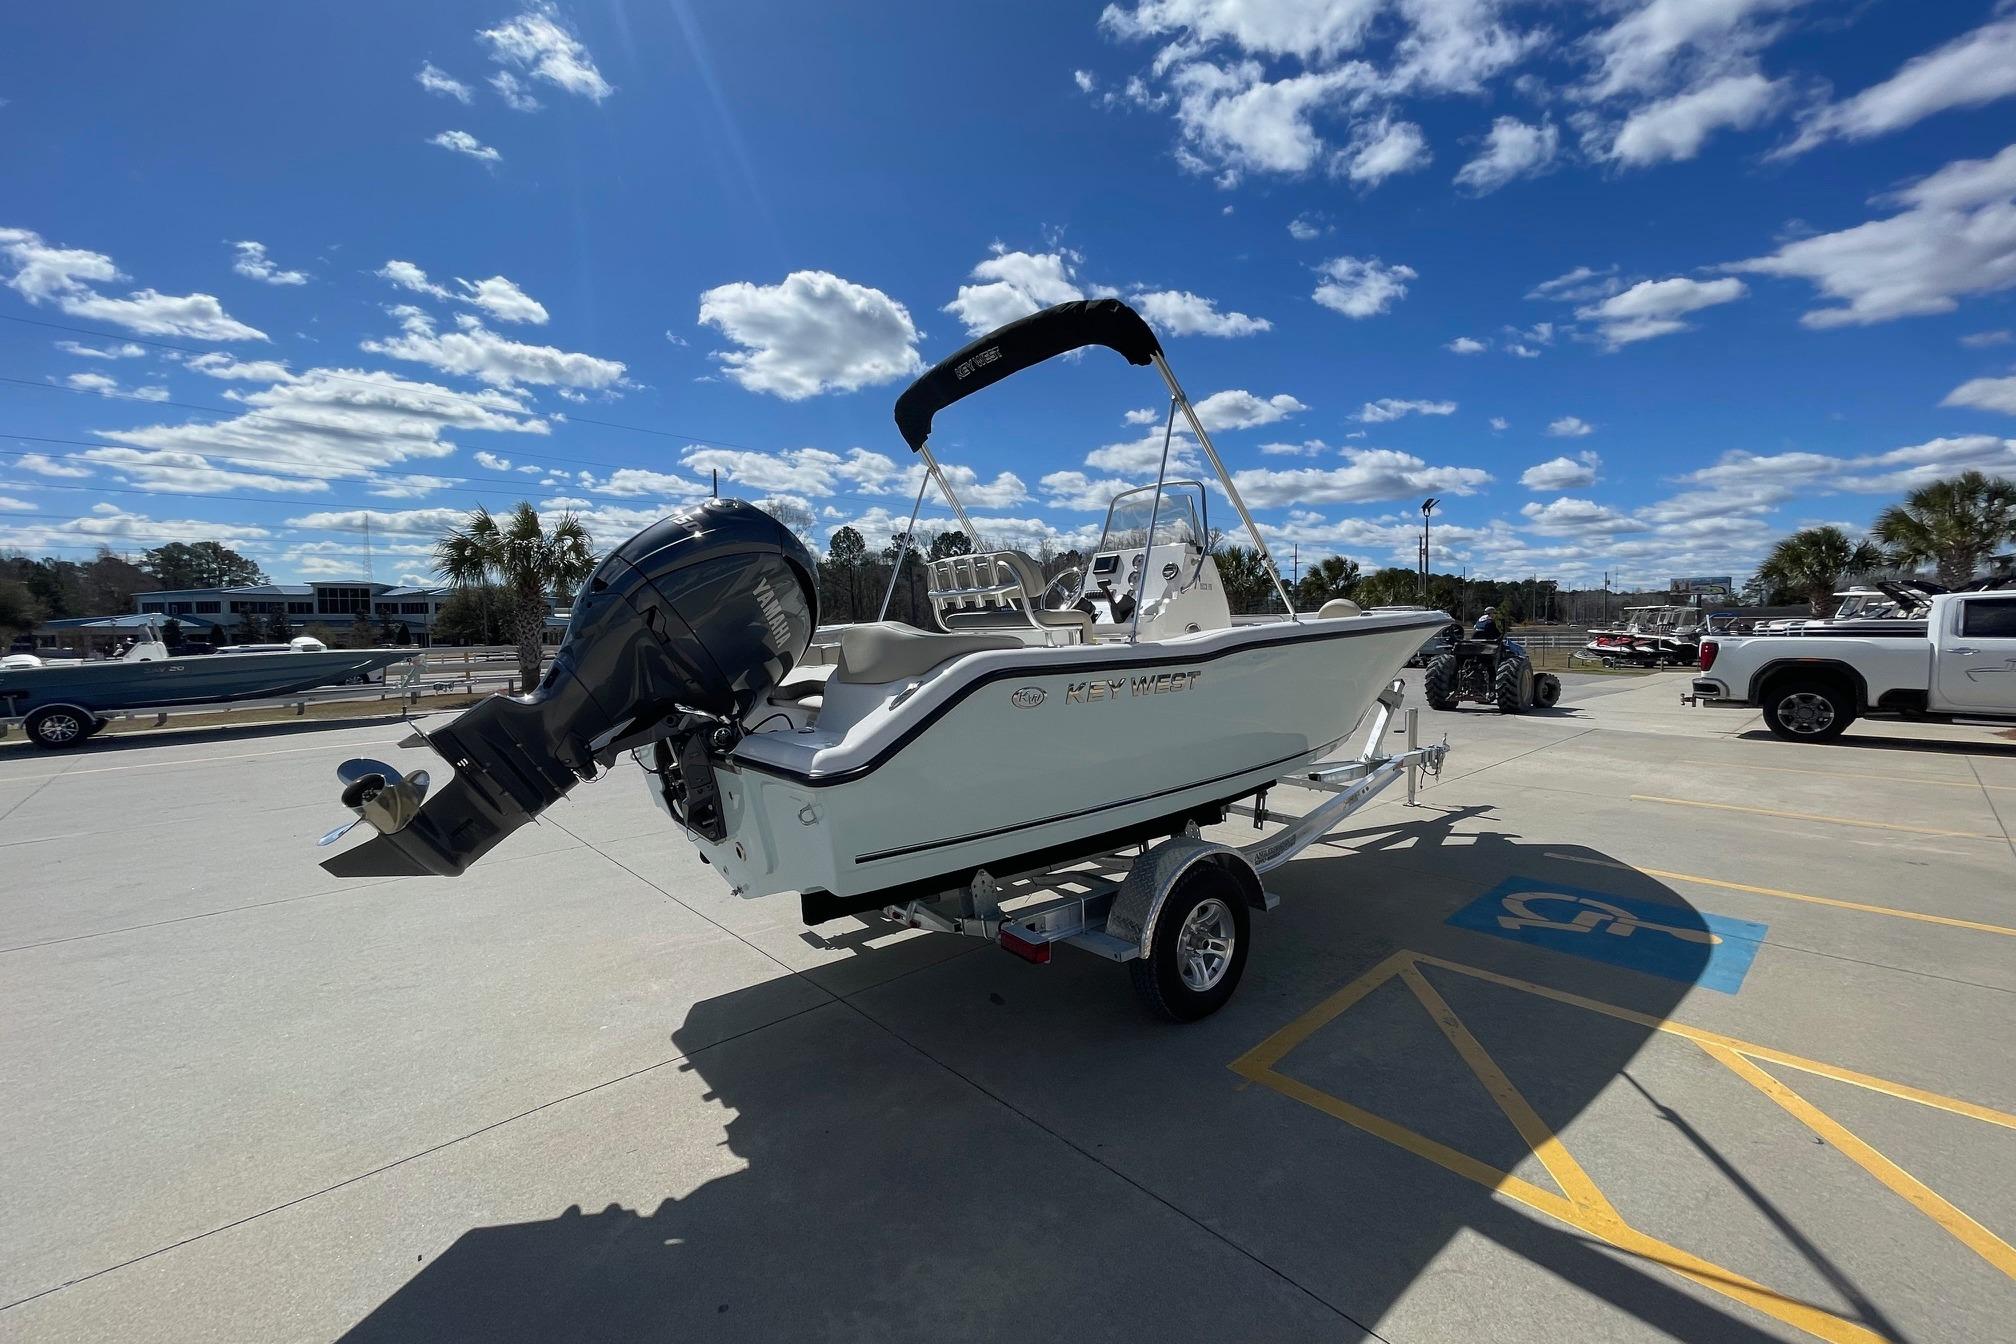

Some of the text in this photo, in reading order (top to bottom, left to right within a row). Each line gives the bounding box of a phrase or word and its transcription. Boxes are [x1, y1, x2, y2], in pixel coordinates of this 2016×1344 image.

[954, 345, 1003, 380] KEY WEST
[752, 577, 792, 649] YAMAHA
[1065, 670, 1202, 705] KEY WEST
